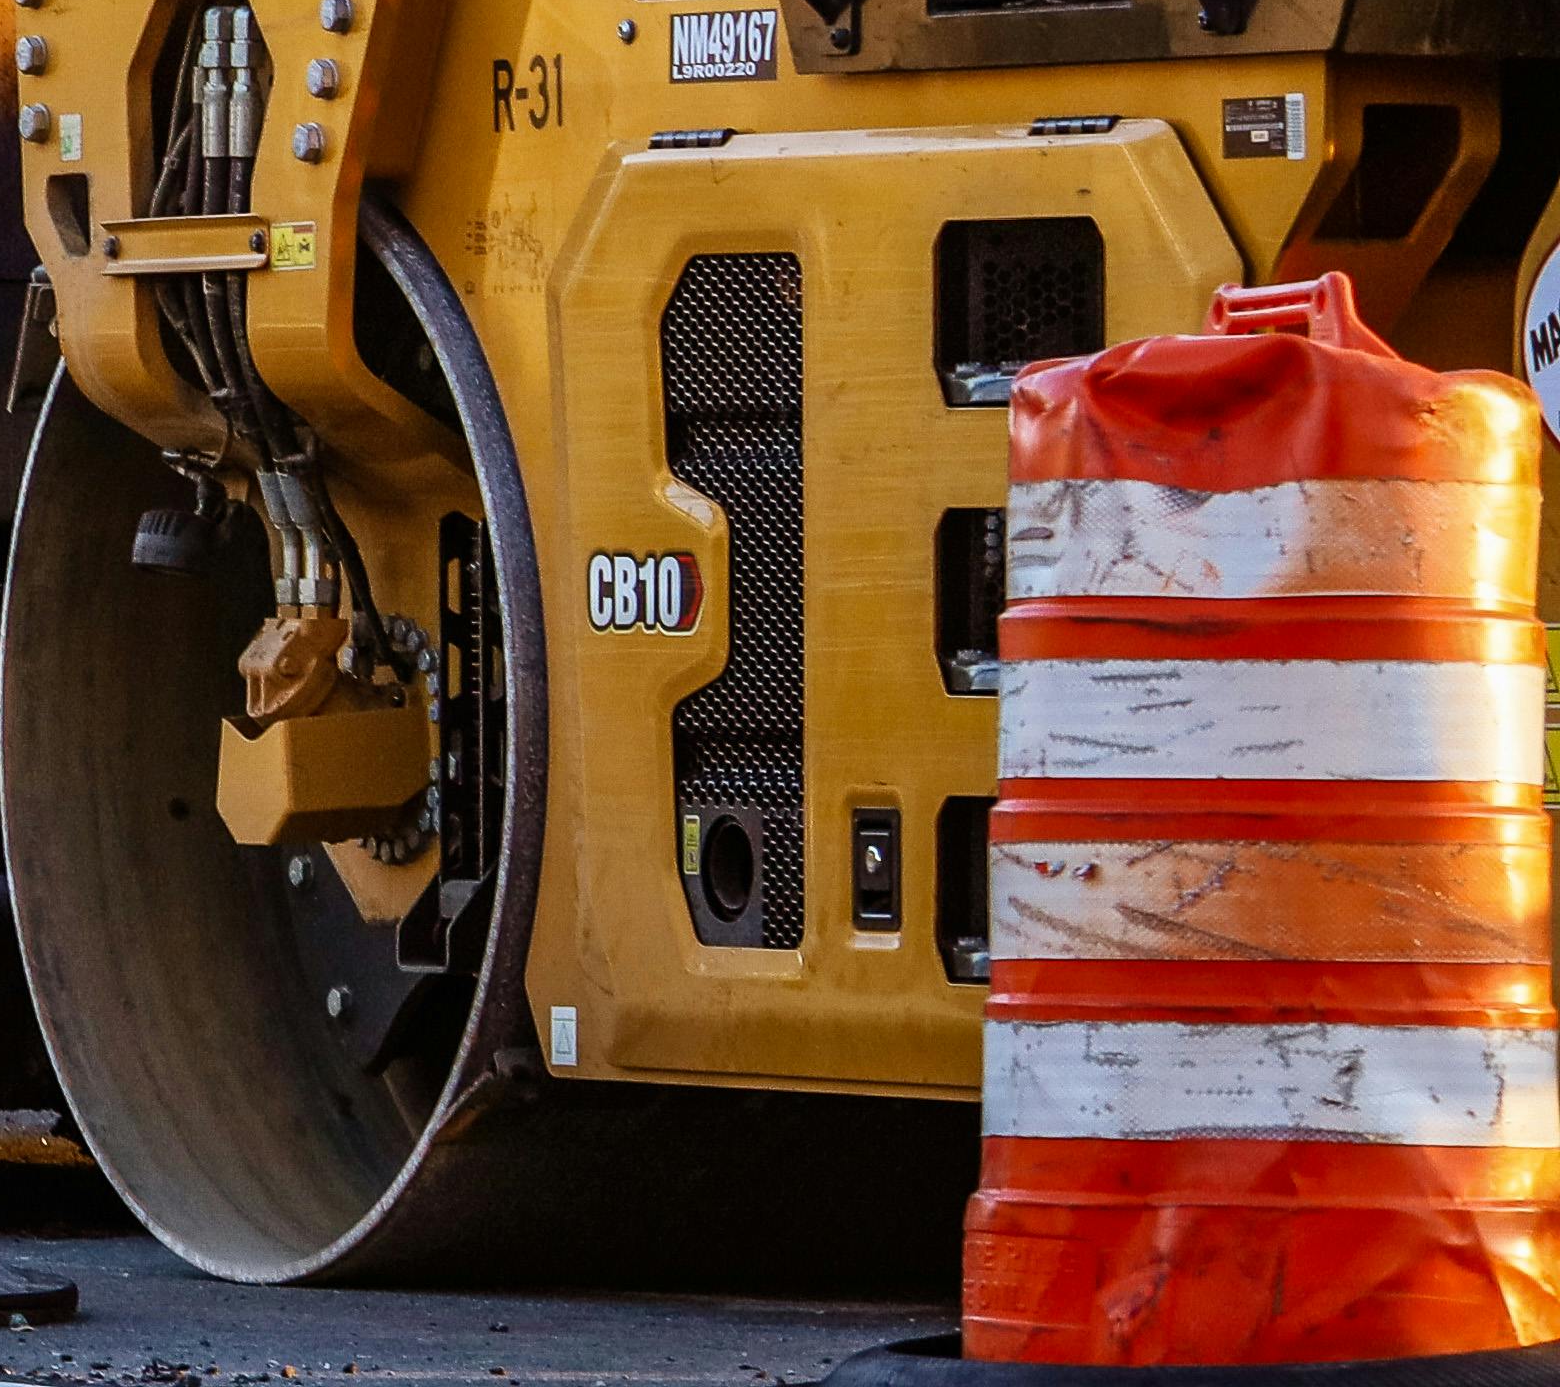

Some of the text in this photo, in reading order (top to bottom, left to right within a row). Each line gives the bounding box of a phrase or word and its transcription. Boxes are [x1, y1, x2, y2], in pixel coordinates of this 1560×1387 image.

[672, 10, 777, 65] NM49167
[492, 52, 563, 132] R-31
[672, 61, 756, 80] L9R00220
[589, 554, 681, 628] CB10
